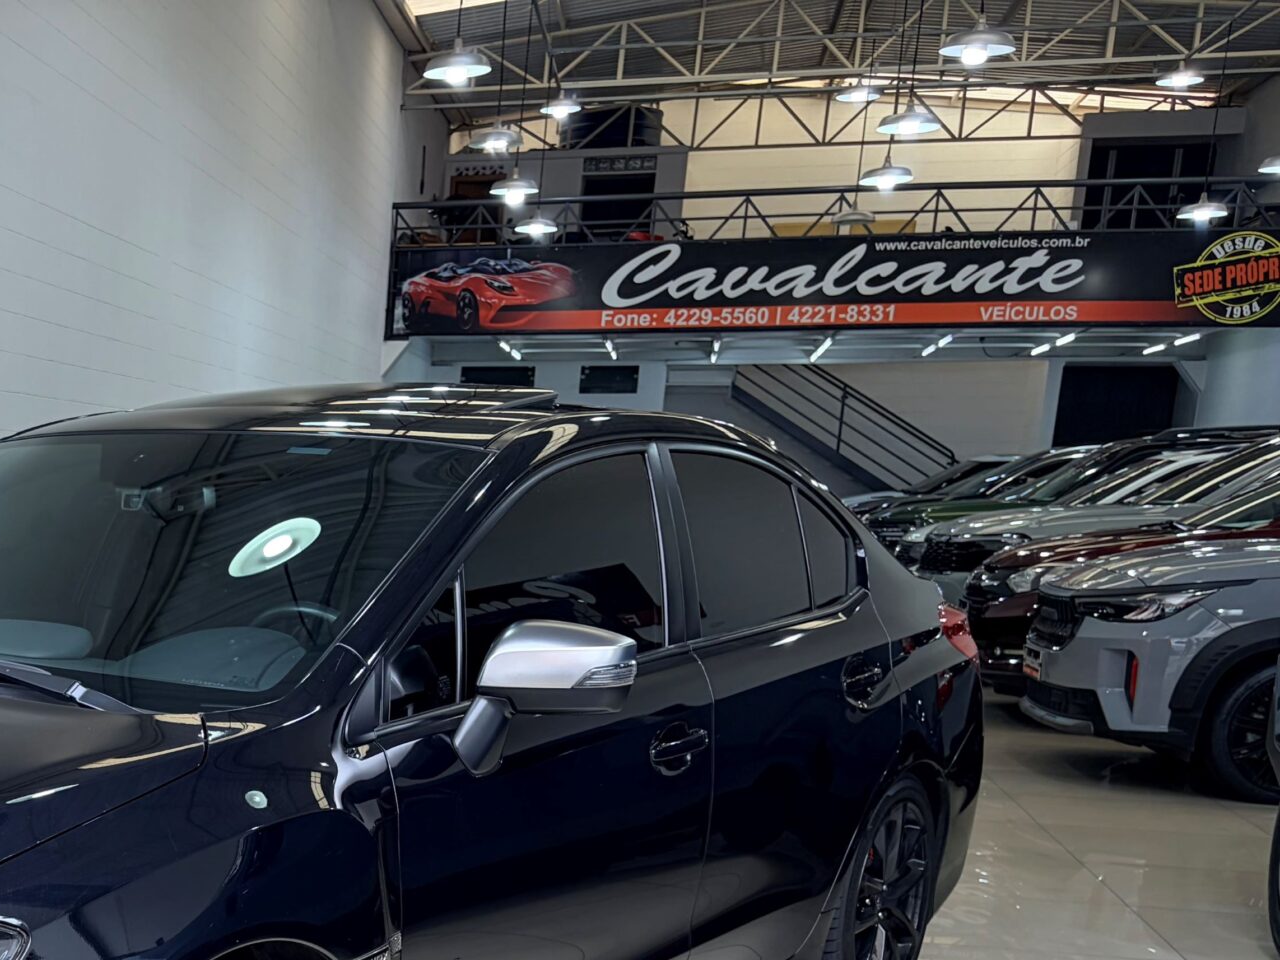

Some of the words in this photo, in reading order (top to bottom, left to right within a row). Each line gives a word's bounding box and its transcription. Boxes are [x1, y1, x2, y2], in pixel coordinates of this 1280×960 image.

[875, 235, 1091, 251] www.cavalcanteveiculos.com.br
[1212, 234, 1265, 259] Desde
[601, 243, 1086, 308] Cavalcante
[1183, 267, 1223, 296] SEDE
[600, 310, 658, 327] Fone:
[663, 307, 769, 325] 4229-5560
[787, 304, 896, 324] 4221-8331
[980, 302, 1078, 321] VEÍCULOS
[1225, 301, 1261, 319] 1984
